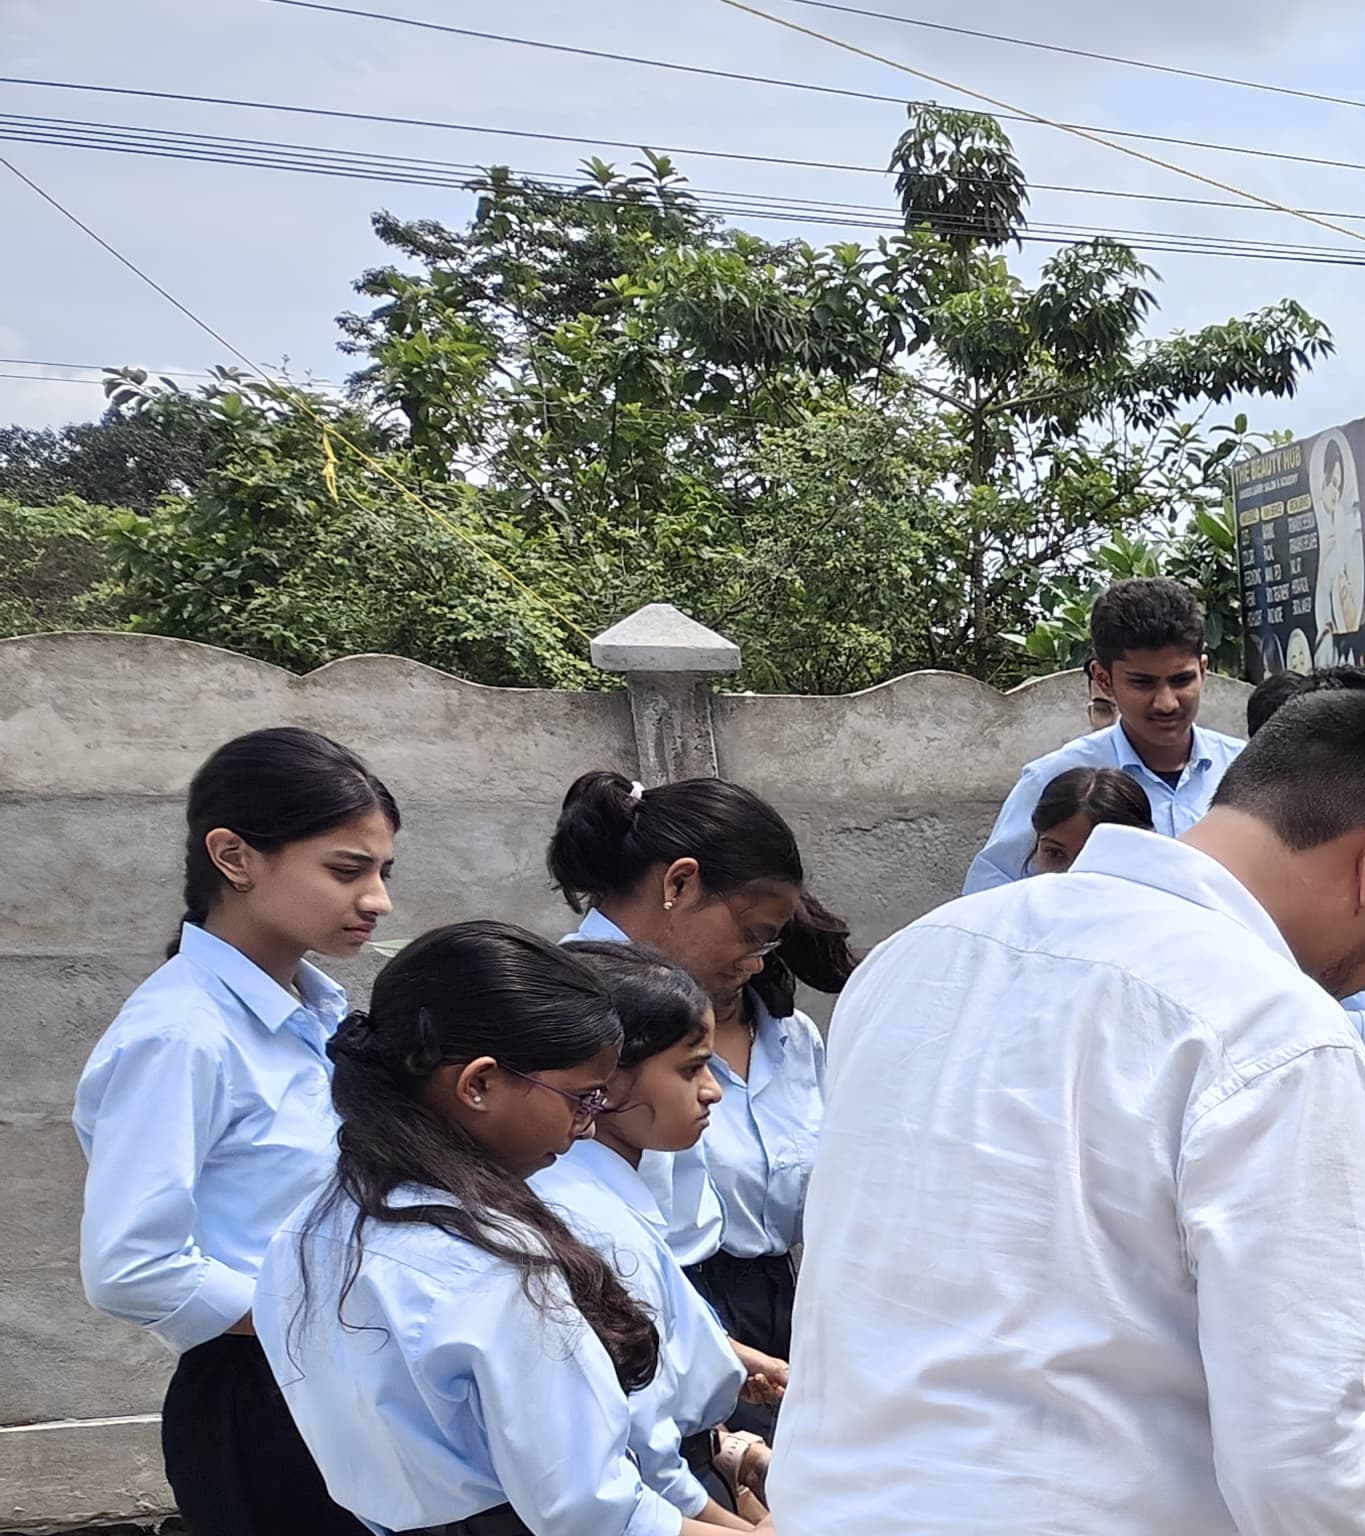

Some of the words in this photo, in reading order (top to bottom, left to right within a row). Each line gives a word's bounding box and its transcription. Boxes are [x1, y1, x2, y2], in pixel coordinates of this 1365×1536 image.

[1235, 462, 1251, 486] THE
[1251, 450, 1281, 480] BEAUTY
[1283, 445, 1302, 471] HUB
